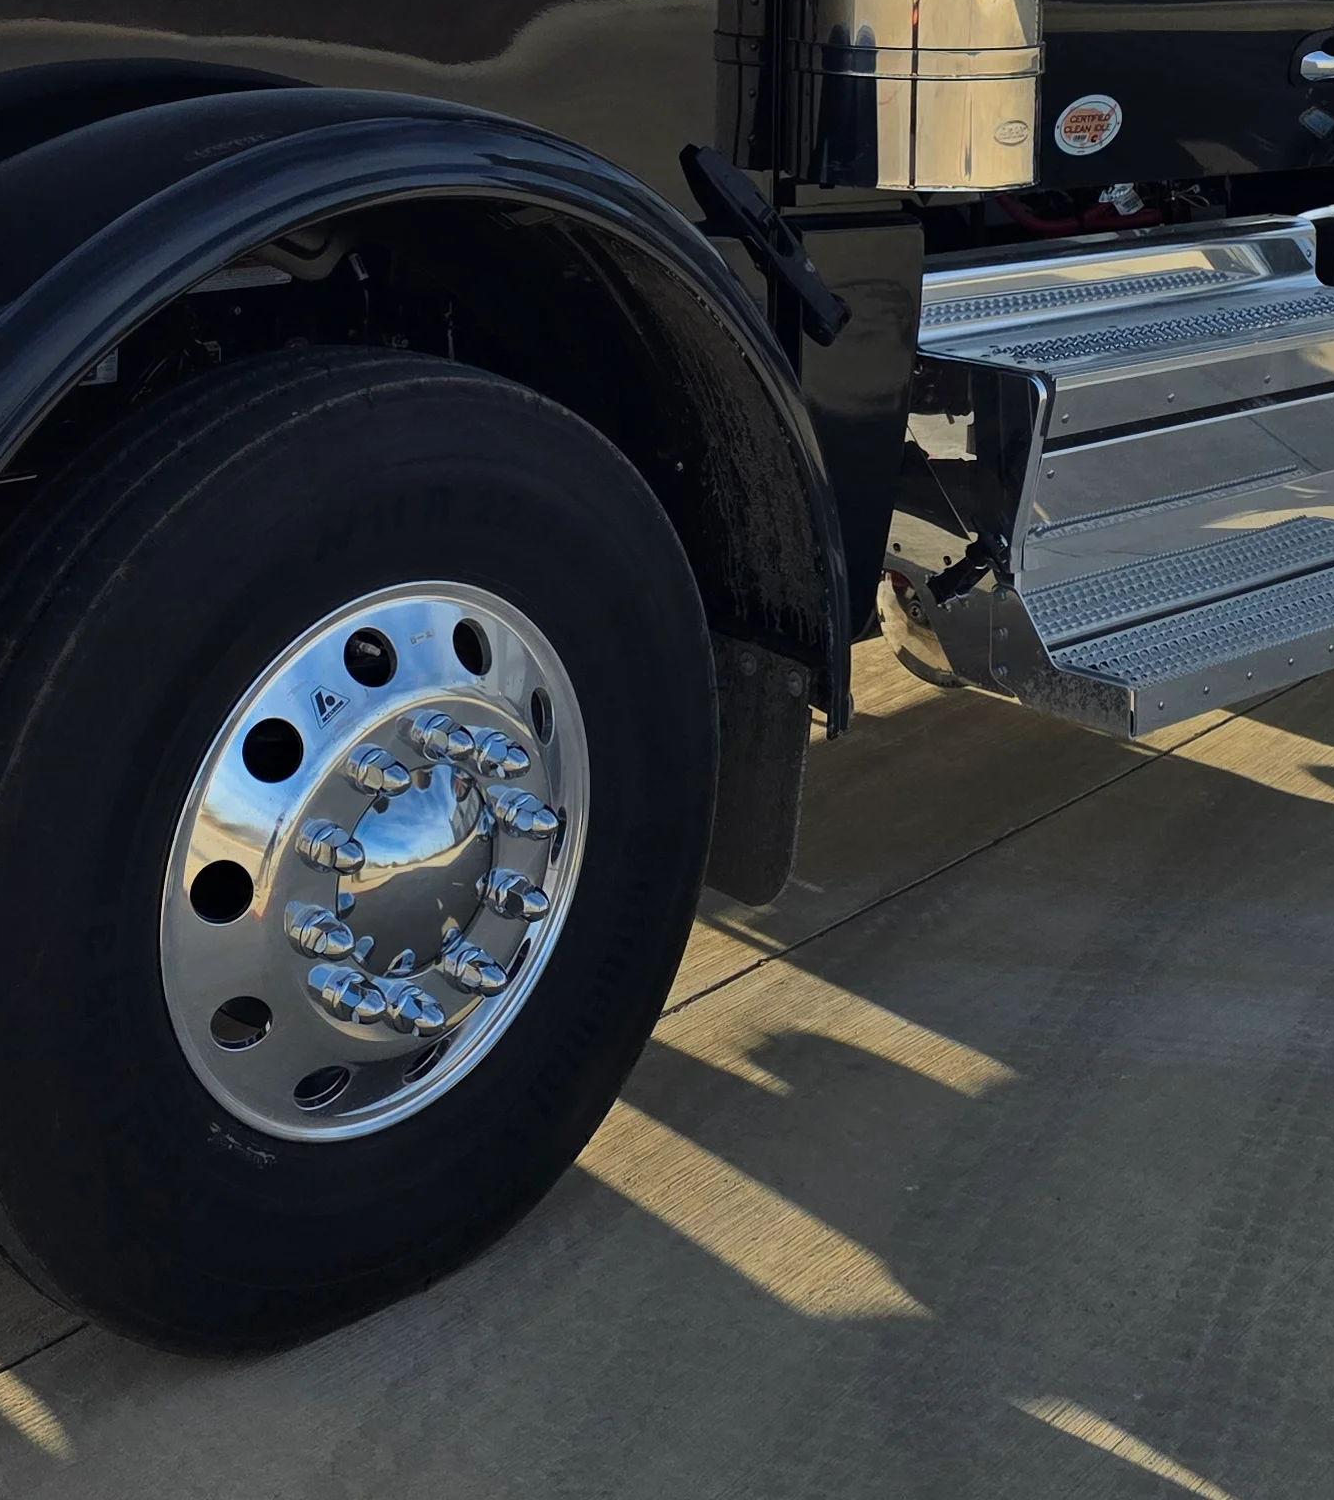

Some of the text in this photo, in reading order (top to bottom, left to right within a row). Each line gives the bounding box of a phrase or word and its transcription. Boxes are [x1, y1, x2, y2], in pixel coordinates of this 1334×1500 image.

[1070, 113, 1111, 124] CERTIFIED
[1064, 123, 1112, 134] CLEAN IDLE
